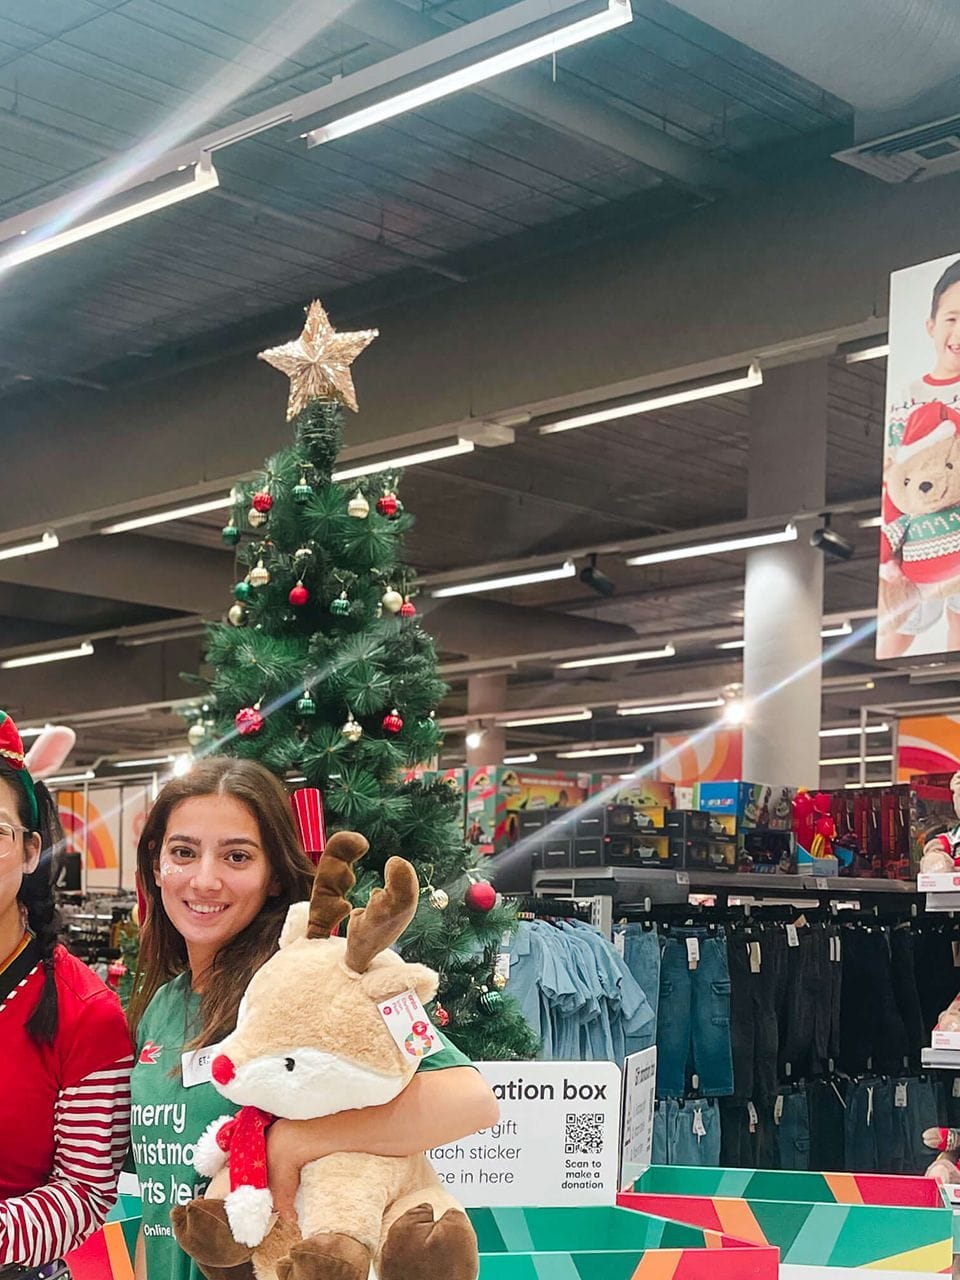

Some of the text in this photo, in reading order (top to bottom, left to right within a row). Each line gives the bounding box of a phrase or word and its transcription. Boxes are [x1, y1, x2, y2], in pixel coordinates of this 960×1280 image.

[492, 1078, 607, 1100] ation box
[131, 1103, 186, 1134] merry
[491, 1120, 518, 1138] gift
[424, 1145, 522, 1160] tach sticker
[565, 1159, 602, 1168] Scan to
[460, 1169, 474, 1184] in
[479, 1169, 514, 1184] here
[565, 1170, 592, 1178] make
[170, 1174, 206, 1207] her
[561, 1180, 604, 1189] donation
[144, 1223, 171, 1236] Online
